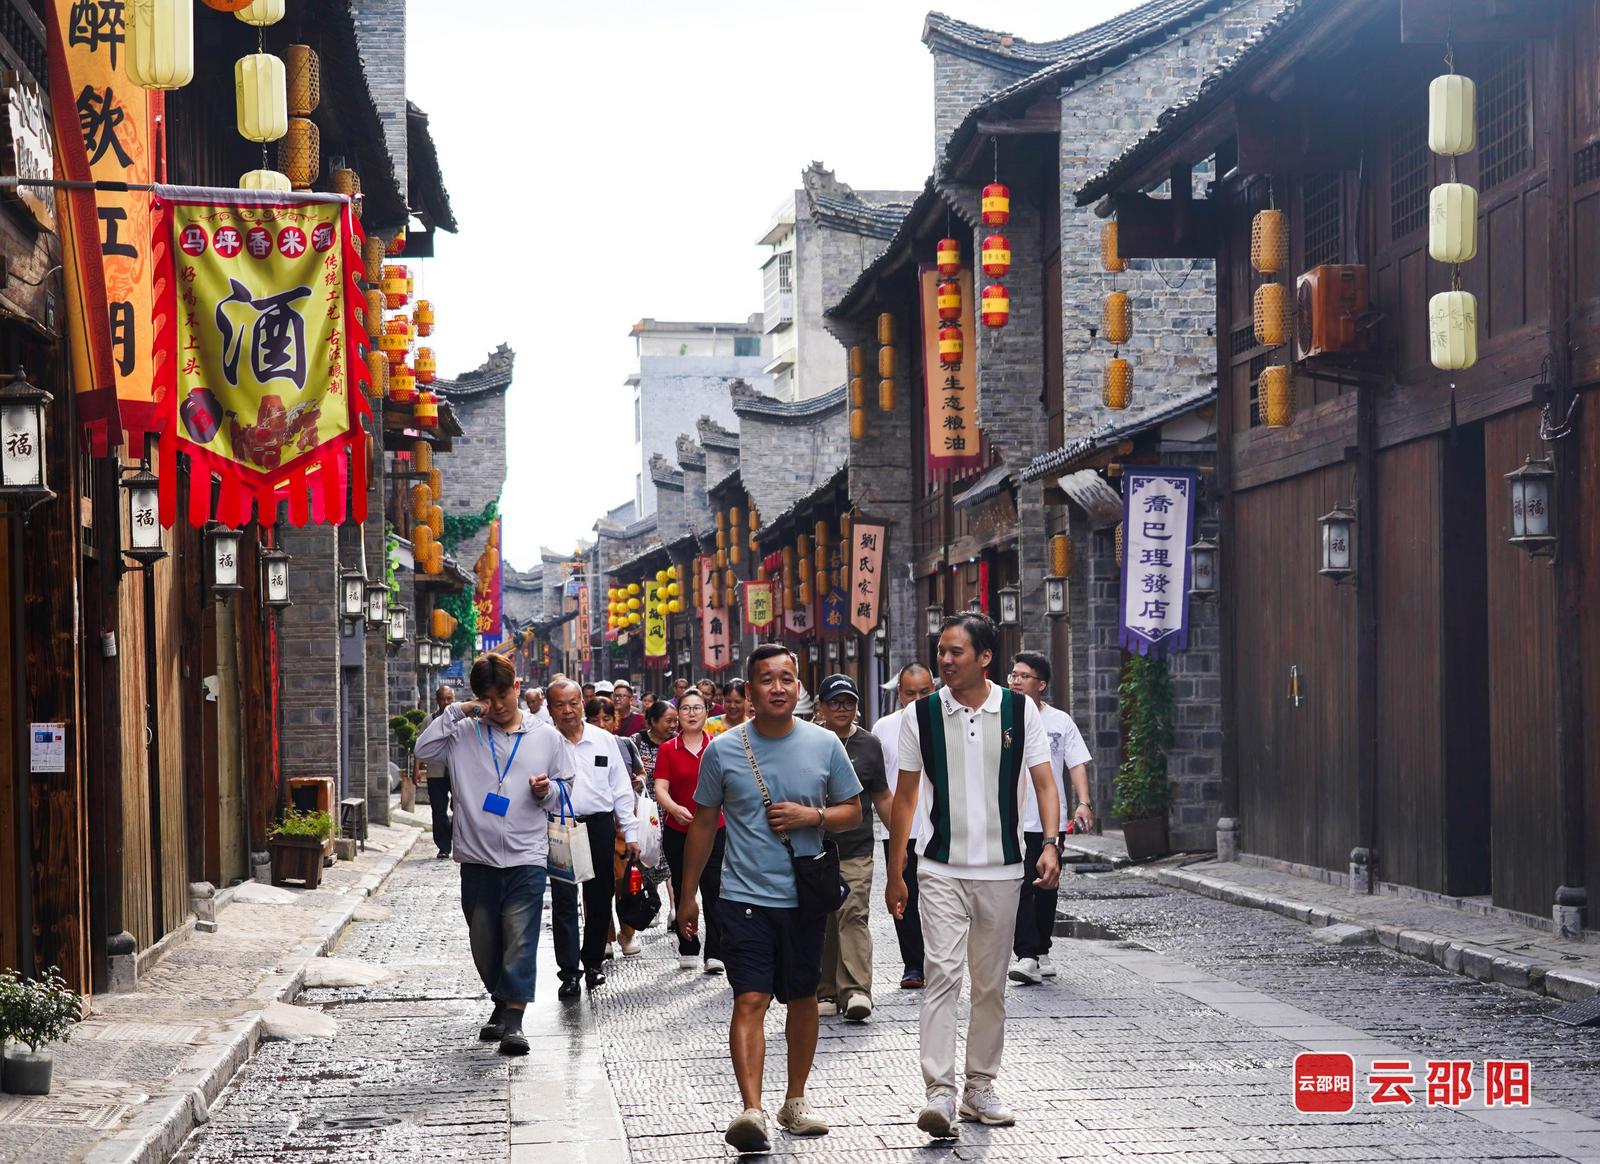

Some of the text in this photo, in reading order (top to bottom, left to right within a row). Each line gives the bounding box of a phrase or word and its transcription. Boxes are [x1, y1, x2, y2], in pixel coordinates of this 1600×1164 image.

[182, 226, 332, 255] 马坪香米酒
[180, 265, 201, 377] 好喝不上头
[214, 276, 314, 392] 酒
[6, 432, 33, 457] 福
[1528, 499, 1544, 517] 福
[136, 508, 155, 527] 福
[1331, 538, 1346, 553] 福
[218, 553, 233, 568] 福
[1139, 494, 1174, 620] 喬巴理發店
[857, 532, 877, 619] 劉氏家醋
[1197, 564, 1210, 578] 福
[271, 574, 284, 587] 福
[348, 591, 359, 602] 福
[371, 600, 381, 610] 福
[1048, 591, 1062, 602] 福
[943, 700, 953, 713] POLO
[742, 734, 751, 750] FACE
[748, 756, 758, 770] THE
[754, 770, 767, 793] NORTH
